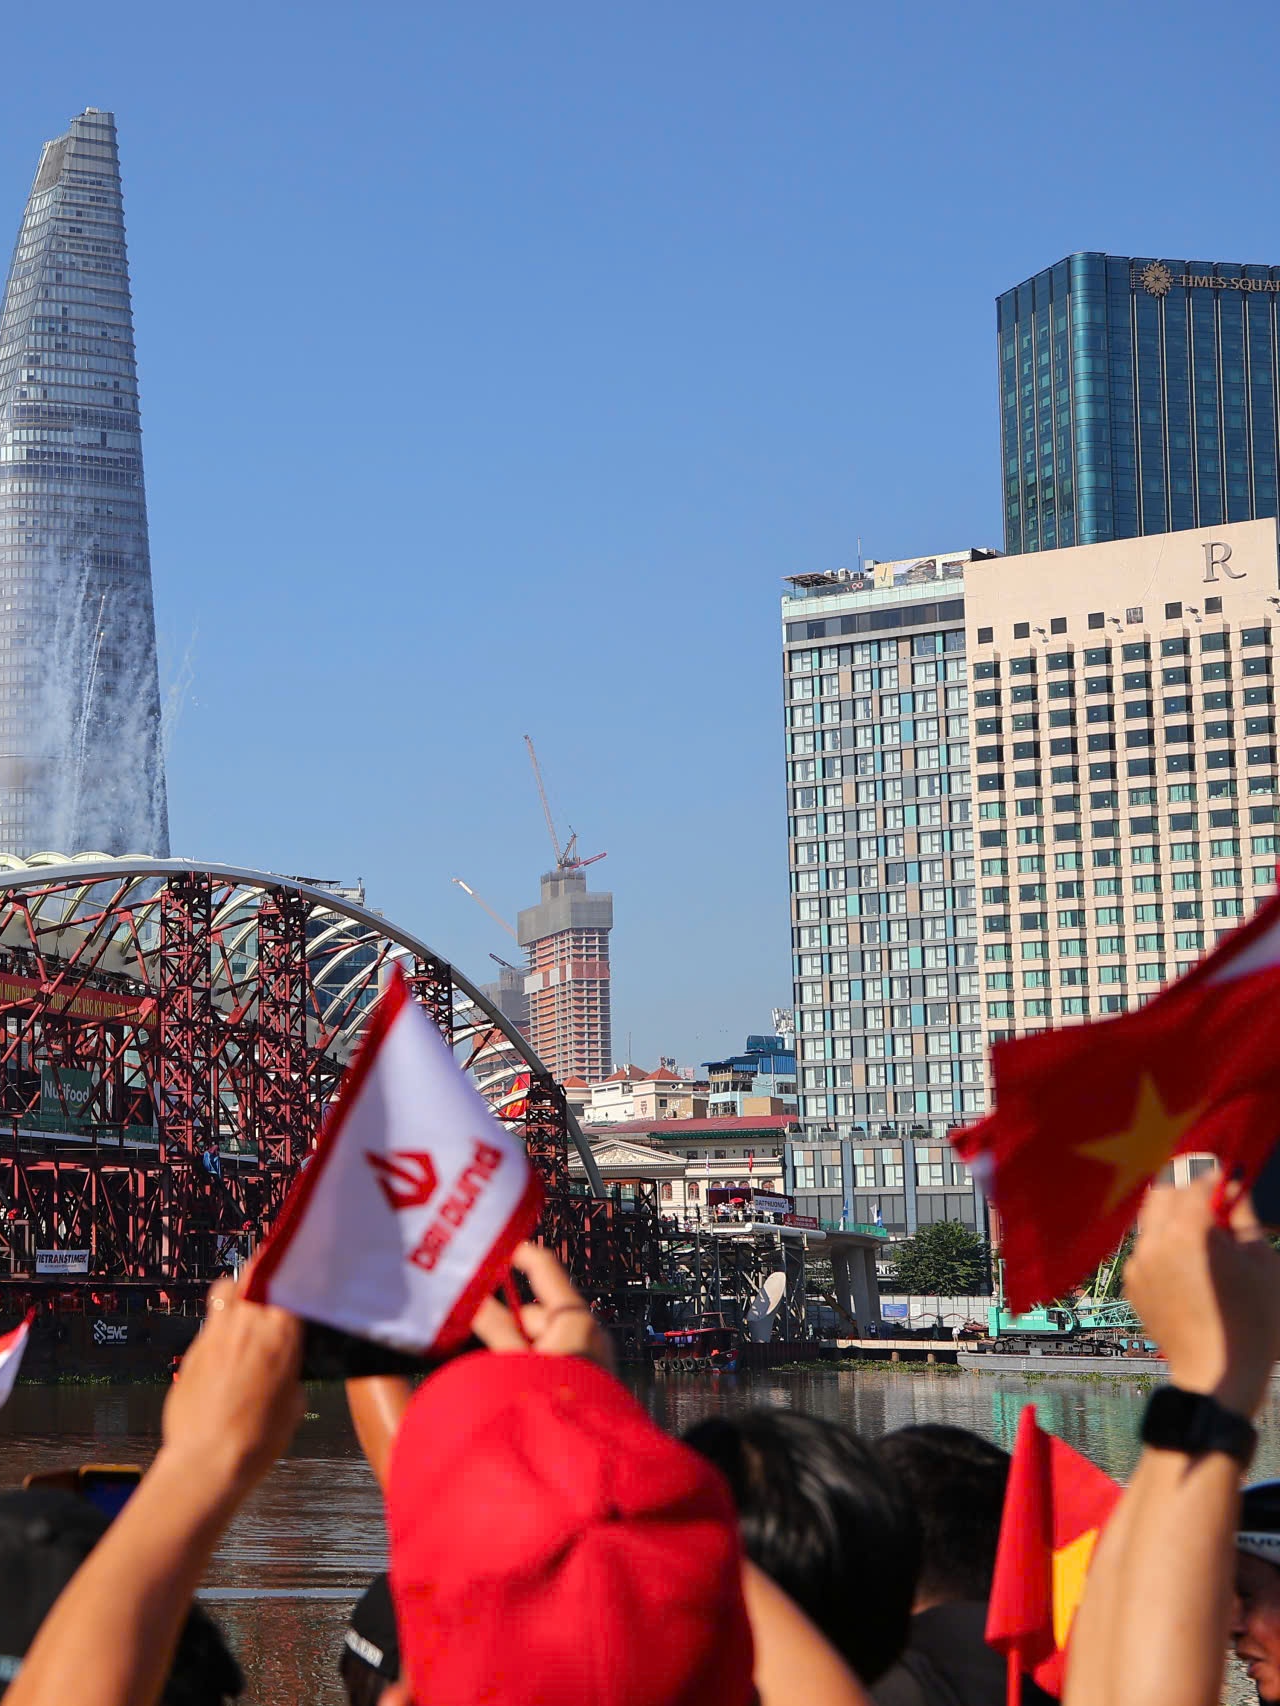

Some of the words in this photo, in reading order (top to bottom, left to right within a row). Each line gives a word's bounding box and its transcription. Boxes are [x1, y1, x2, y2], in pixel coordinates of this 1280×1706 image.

[1180, 275, 1227, 289] TIMES
[1201, 541, 1247, 583] R
[5, 983, 20, 1002] MINH
[44, 1080, 90, 1103] Nuifood
